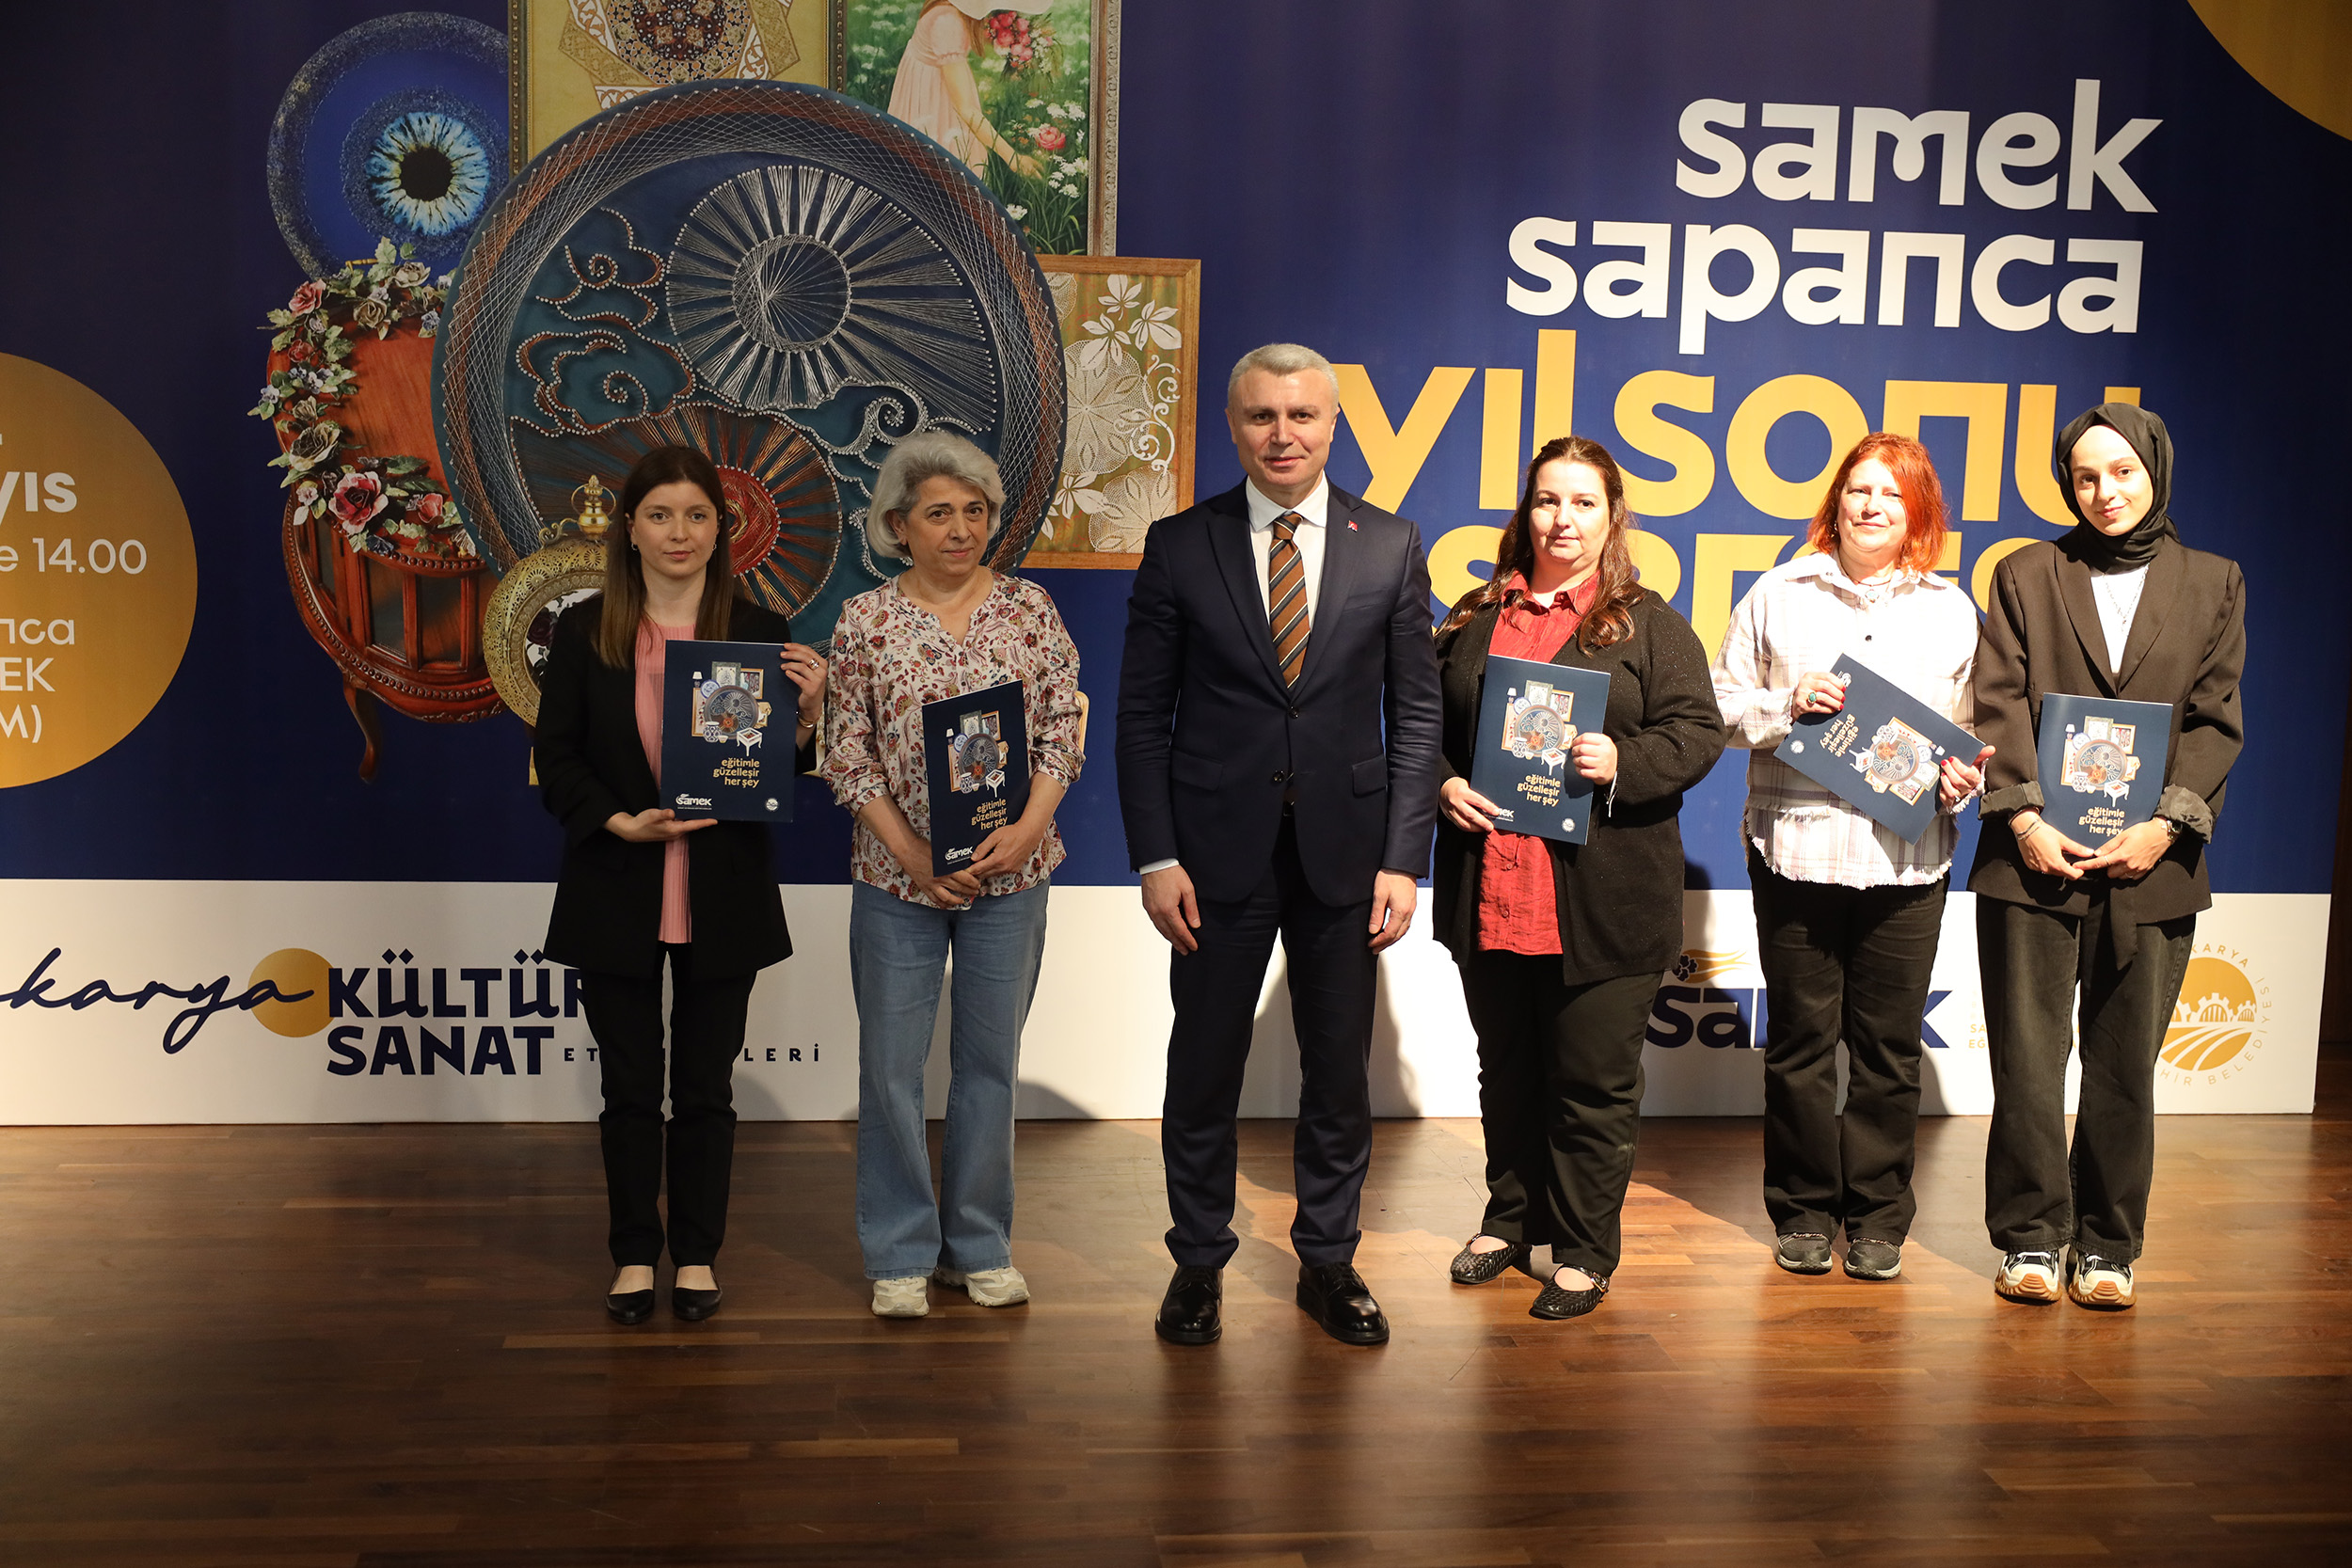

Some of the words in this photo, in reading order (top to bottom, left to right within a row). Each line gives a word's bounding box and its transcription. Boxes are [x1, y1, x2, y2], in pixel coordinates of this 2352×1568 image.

[1676, 78, 2164, 213] samek
[1506, 216, 2144, 356] sapanca
[32, 537, 148, 575] 14.00
[721, 757, 760, 768] eğitimle
[712, 768, 760, 779] güzelleşir
[1525, 773, 1561, 788] eğitimle
[724, 776, 741, 785] her
[741, 779, 760, 788] şey
[1517, 782, 1560, 797] güzelleşir
[1526, 792, 1542, 802] her
[1542, 797, 1560, 807] şey
[2088, 806, 2125, 818] eğitimle
[2078, 815, 2124, 828] güzelleşir
[2090, 824, 2106, 834] her
[2106, 828, 2123, 837] şey
[326, 1024, 555, 1076] SANAT
